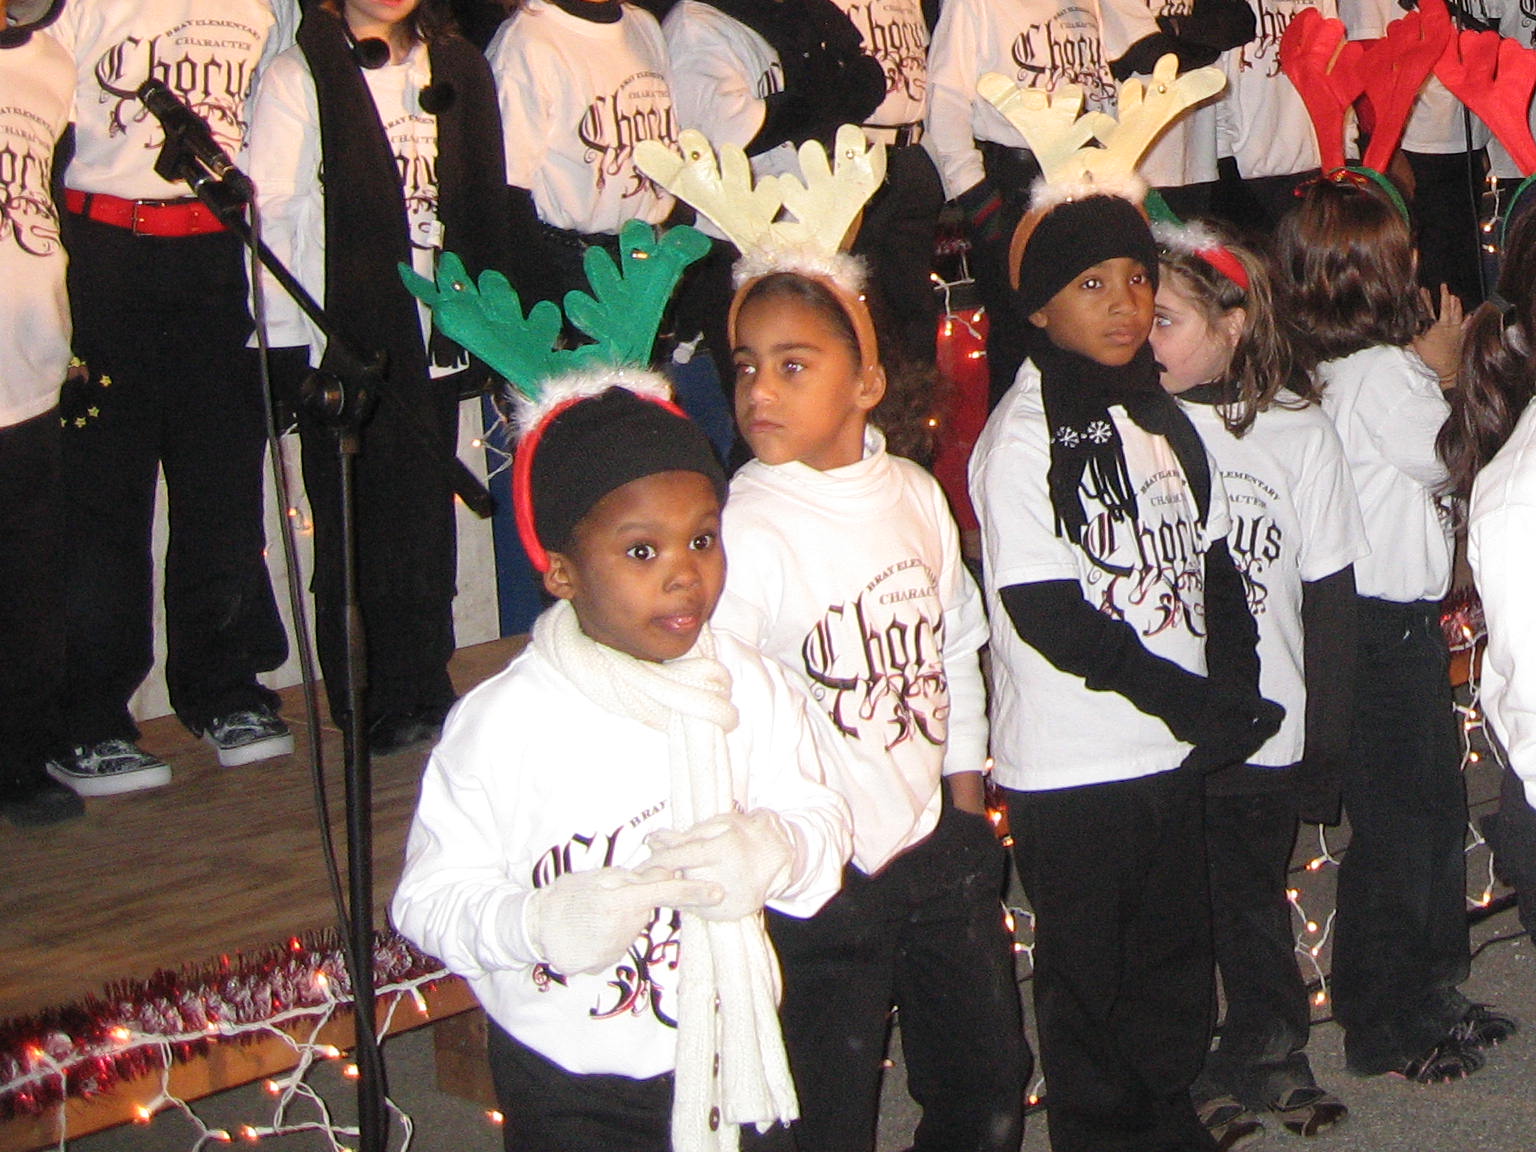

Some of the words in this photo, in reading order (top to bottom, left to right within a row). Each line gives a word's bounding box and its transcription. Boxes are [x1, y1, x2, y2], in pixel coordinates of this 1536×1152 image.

[166, 19, 195, 38] BRAY
[94, 34, 253, 100] Choru
[1219, 471, 1281, 501] LEMENTARY
[866, 566, 895, 592] BRAY
[879, 586, 938, 605] CHARAC
[629, 800, 668, 828] BRAY
